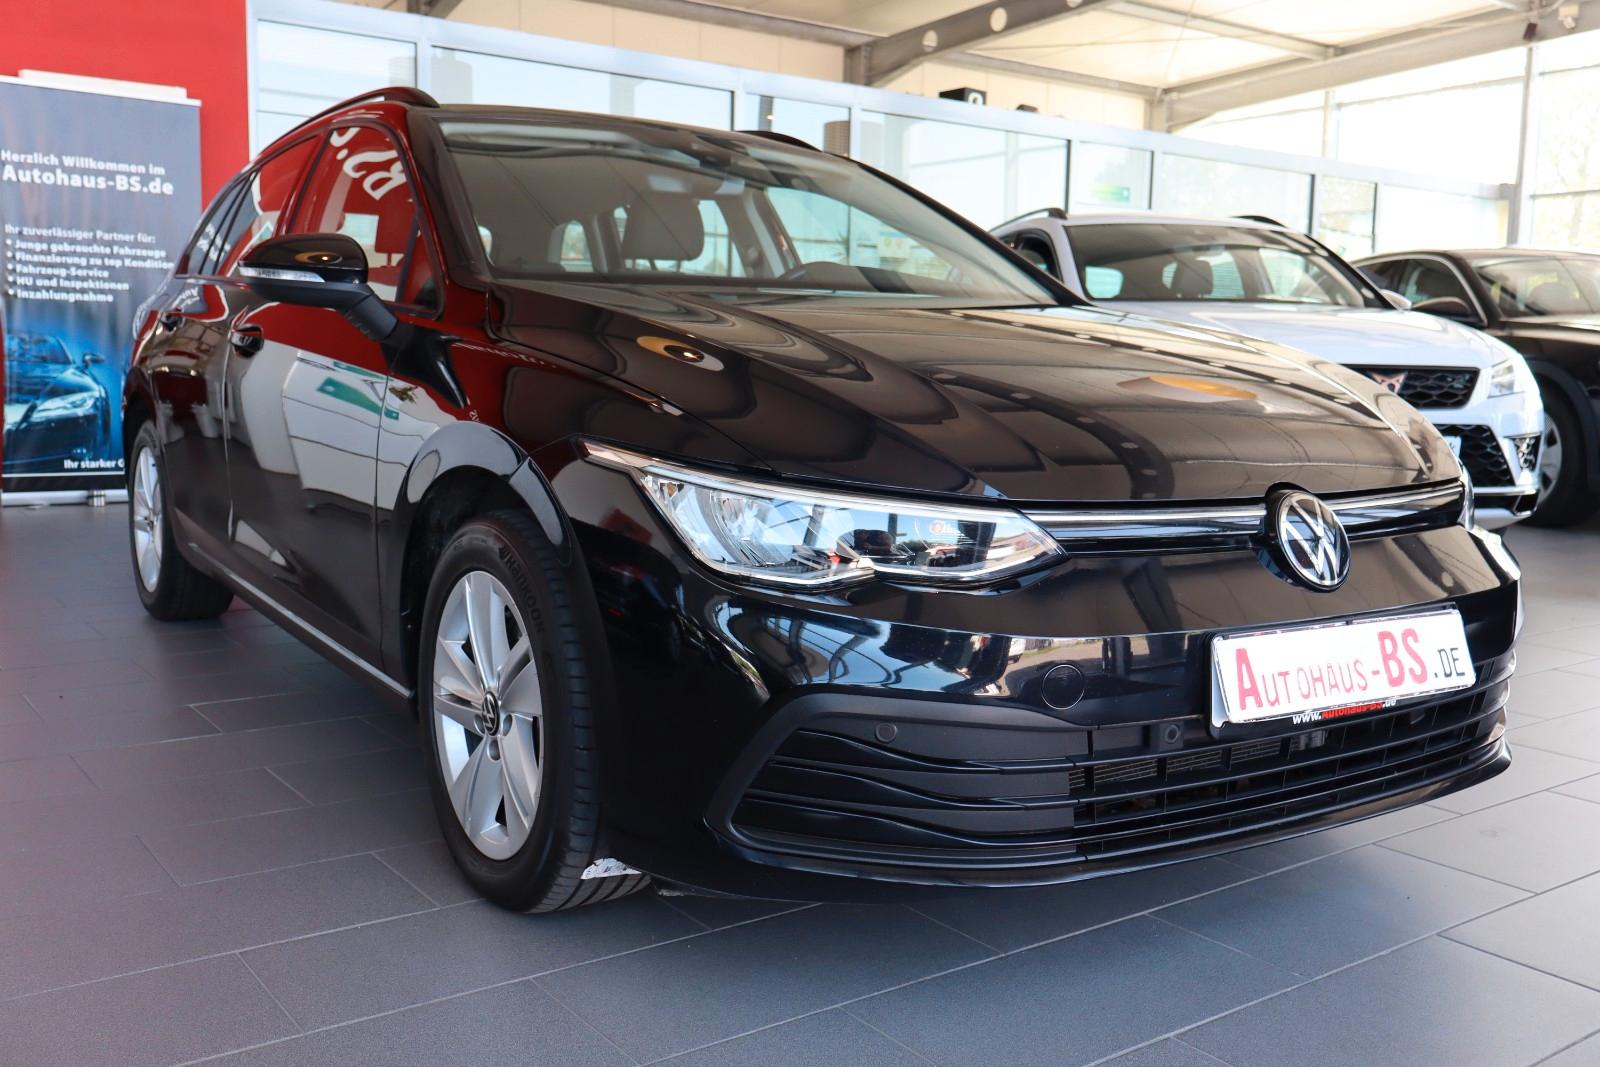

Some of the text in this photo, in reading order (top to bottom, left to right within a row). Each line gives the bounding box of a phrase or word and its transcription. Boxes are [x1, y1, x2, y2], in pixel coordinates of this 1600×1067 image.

[1, 150, 165, 176] Herzlich Willkommen im
[2, 164, 174, 195] Autohaus-BS.de
[5, 223, 19, 234] Ihr
[22, 226, 93, 241] zuverlässiger
[96, 230, 134, 242] Partner
[15, 239, 167, 259] Junge gebrauchte Fahrzeuge
[15, 251, 87, 267] Finanzierung
[104, 257, 122, 268] top
[124, 257, 175, 270] Kondition
[16, 263, 109, 278] Fahrzeug-Service
[16, 276, 129, 291] HU und Inspektionen
[17, 288, 114, 303] Inzahlungnahme
[63, 459, 78, 469] Ihr
[80, 457, 116, 469] starker
